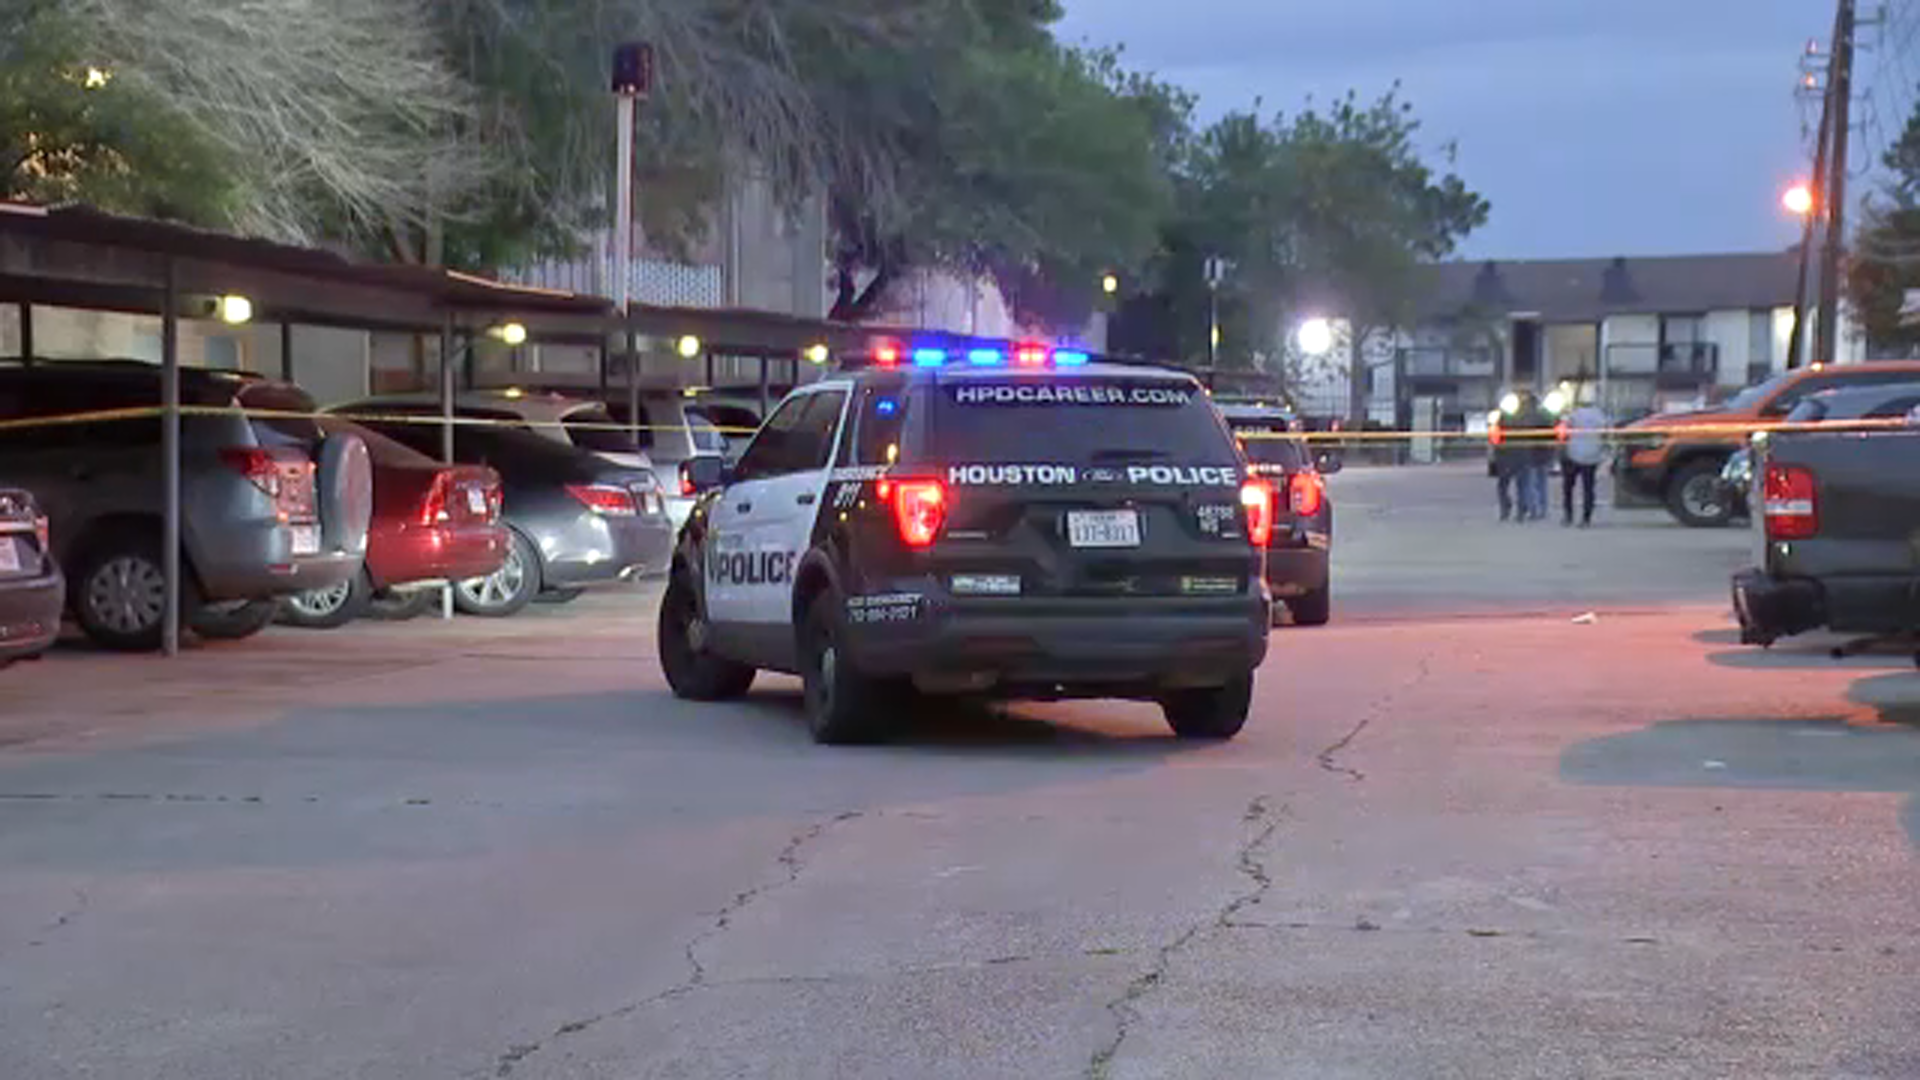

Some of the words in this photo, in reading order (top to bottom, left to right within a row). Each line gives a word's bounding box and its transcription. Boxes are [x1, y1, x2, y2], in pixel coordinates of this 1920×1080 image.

[956, 386, 1192, 405] HPDCAREER.COM
[949, 465, 1076, 485] HOUSTON
[1126, 466, 1238, 486] POLICE
[716, 551, 796, 586] POLICE
